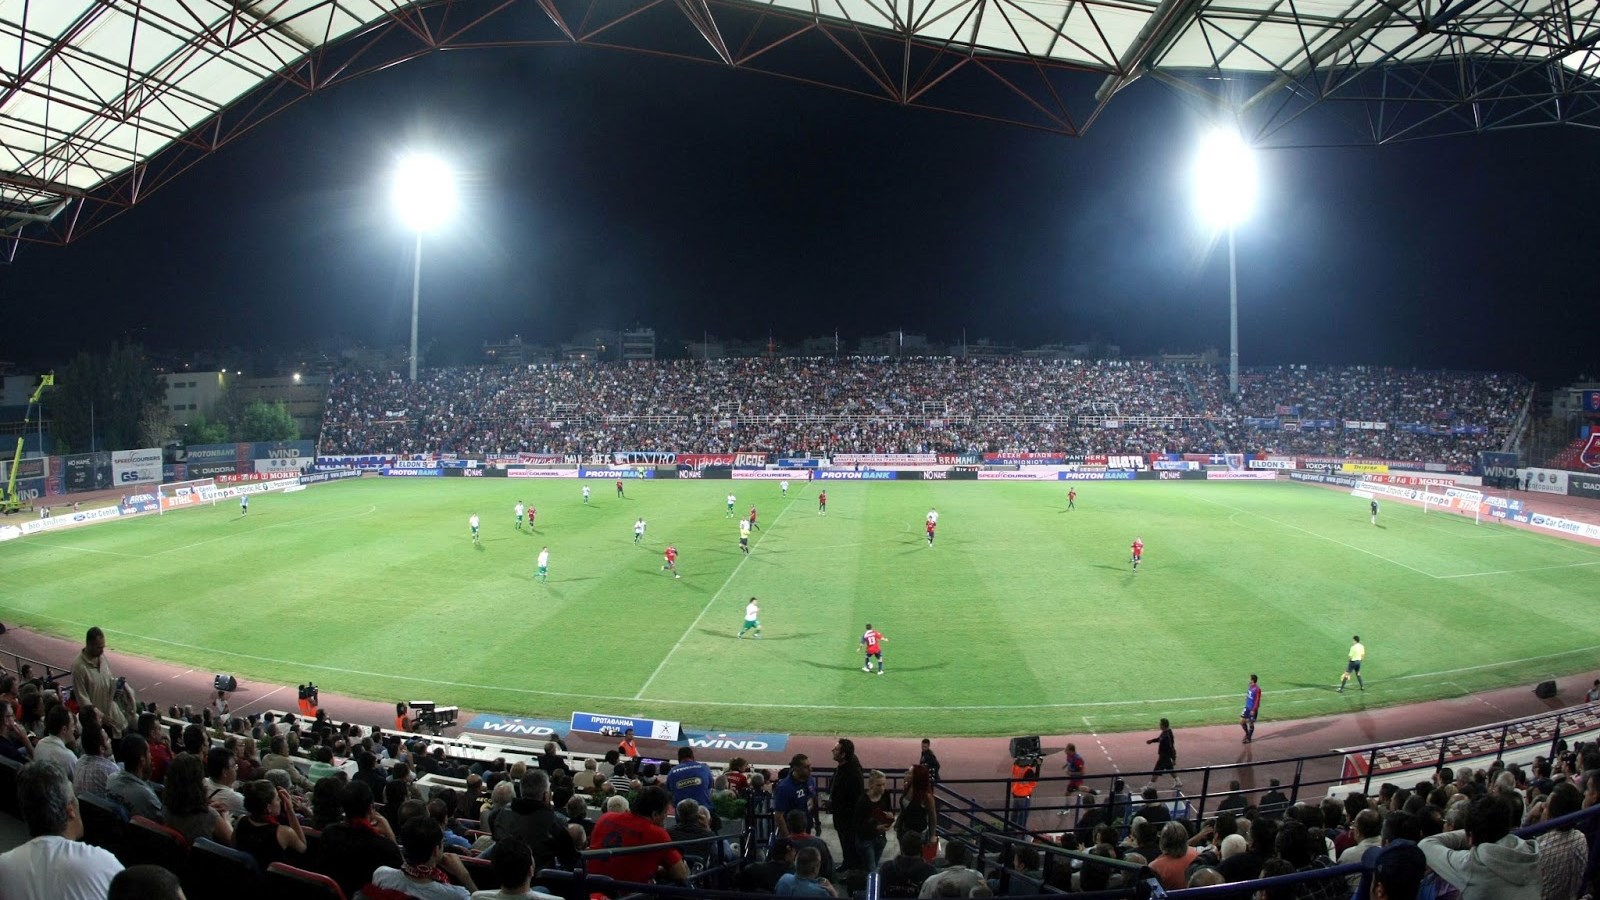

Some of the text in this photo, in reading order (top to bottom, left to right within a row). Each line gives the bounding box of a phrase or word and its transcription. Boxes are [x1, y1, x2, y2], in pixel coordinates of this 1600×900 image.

[268, 449, 300, 458] WIND
[626, 453, 676, 464] CENTRO
[734, 454, 766, 467] ARGOS
[202, 466, 236, 475] DIADORA
[924, 471, 933, 480] NO
[1160, 471, 1168, 479] NO
[1483, 466, 1515, 478] WIND
[122, 471, 138, 482] GS
[168, 495, 193, 506] STIHL
[202, 490, 234, 500] Europa
[87, 510, 98, 519] Car
[99, 506, 118, 517] Center
[1546, 518, 1556, 527] Car
[1558, 520, 1580, 531] Center
[591, 716, 634, 727] ΠΡΩΤΑΘΛΗΜΑ
[483, 721, 554, 735] WIND
[688, 738, 768, 750] WIND
[796, 790, 805, 798] 22
